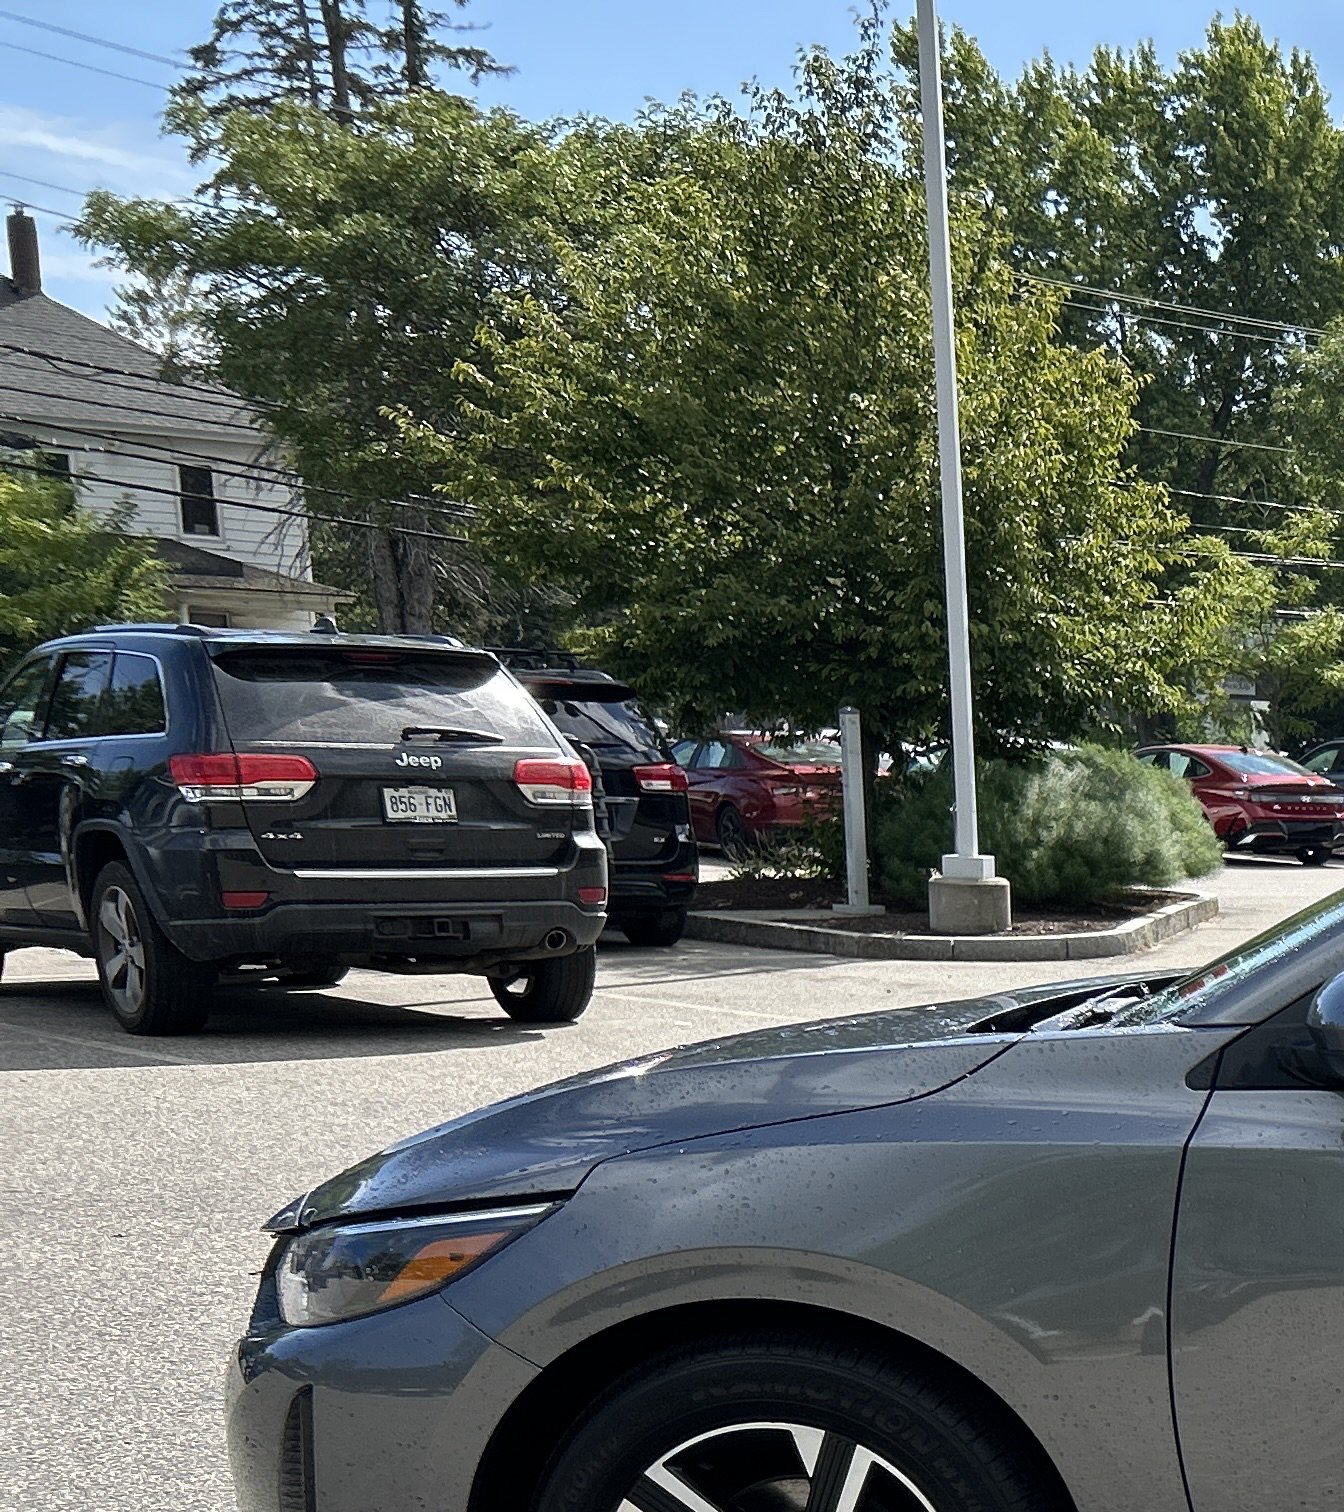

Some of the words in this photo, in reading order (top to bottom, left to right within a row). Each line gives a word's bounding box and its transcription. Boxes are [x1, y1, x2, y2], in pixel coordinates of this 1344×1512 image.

[395, 752, 442, 770] Jeep
[389, 795, 417, 813] 856
[424, 795, 453, 814] FGN
